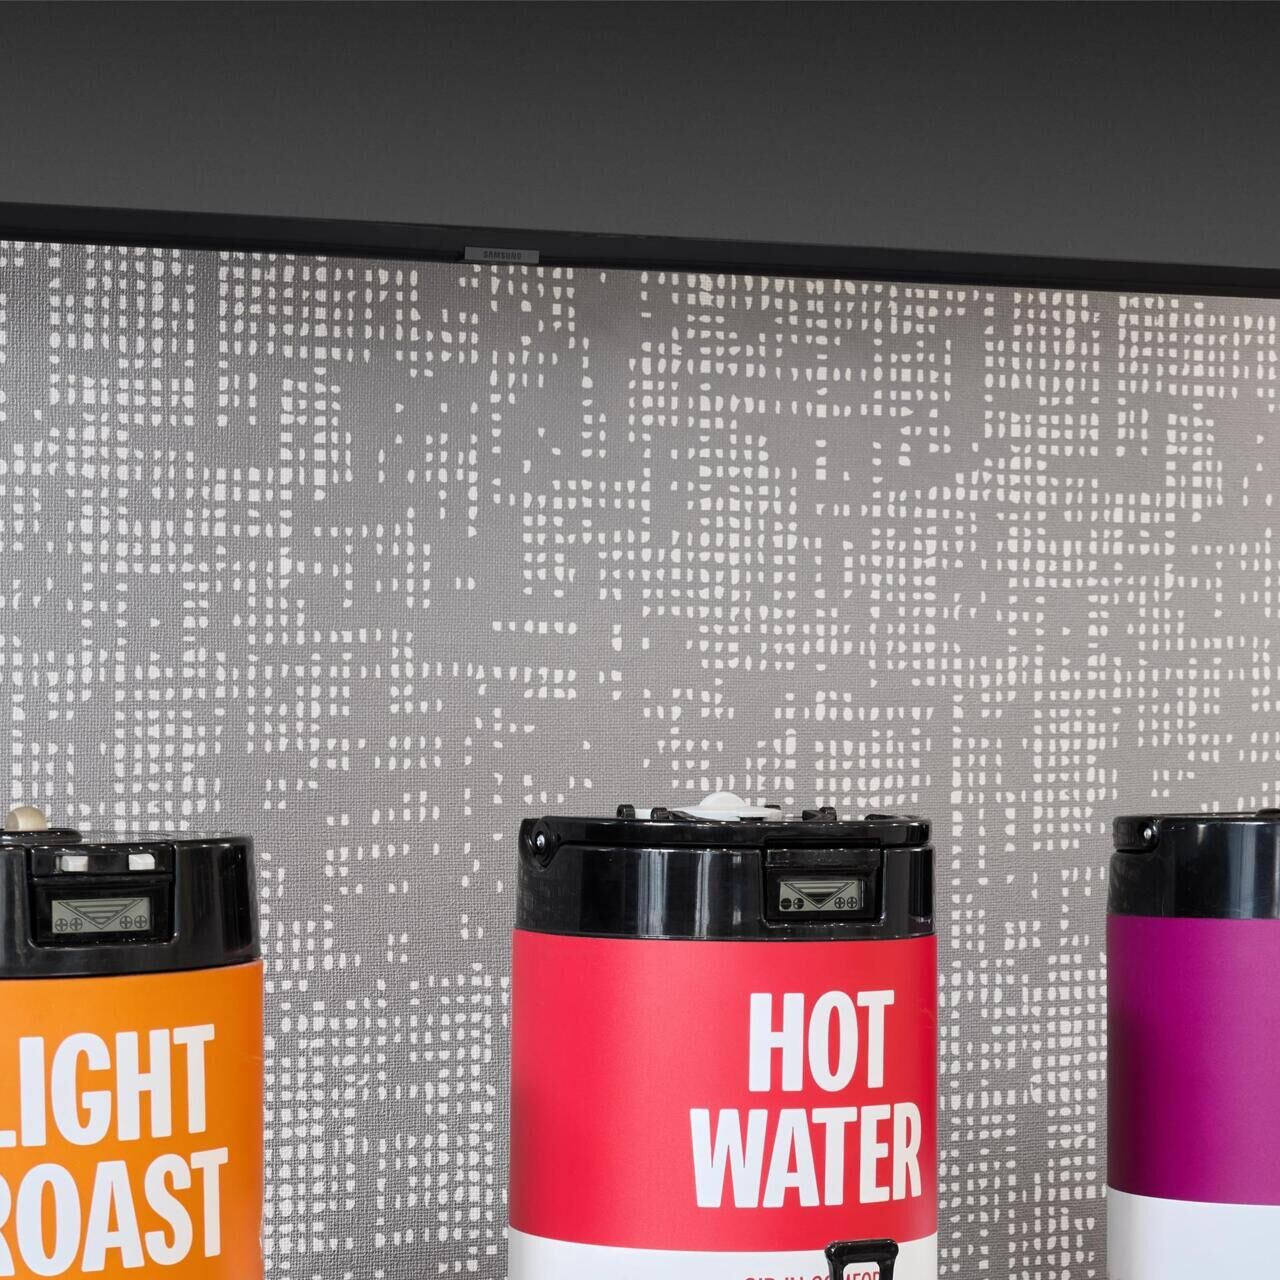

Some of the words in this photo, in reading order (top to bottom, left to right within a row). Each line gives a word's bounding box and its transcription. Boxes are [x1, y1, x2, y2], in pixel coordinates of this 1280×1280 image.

[483, 250, 522, 260] SAMSUNG
[748, 990, 895, 1092] HOT
[689, 1102, 922, 1208] WATER
